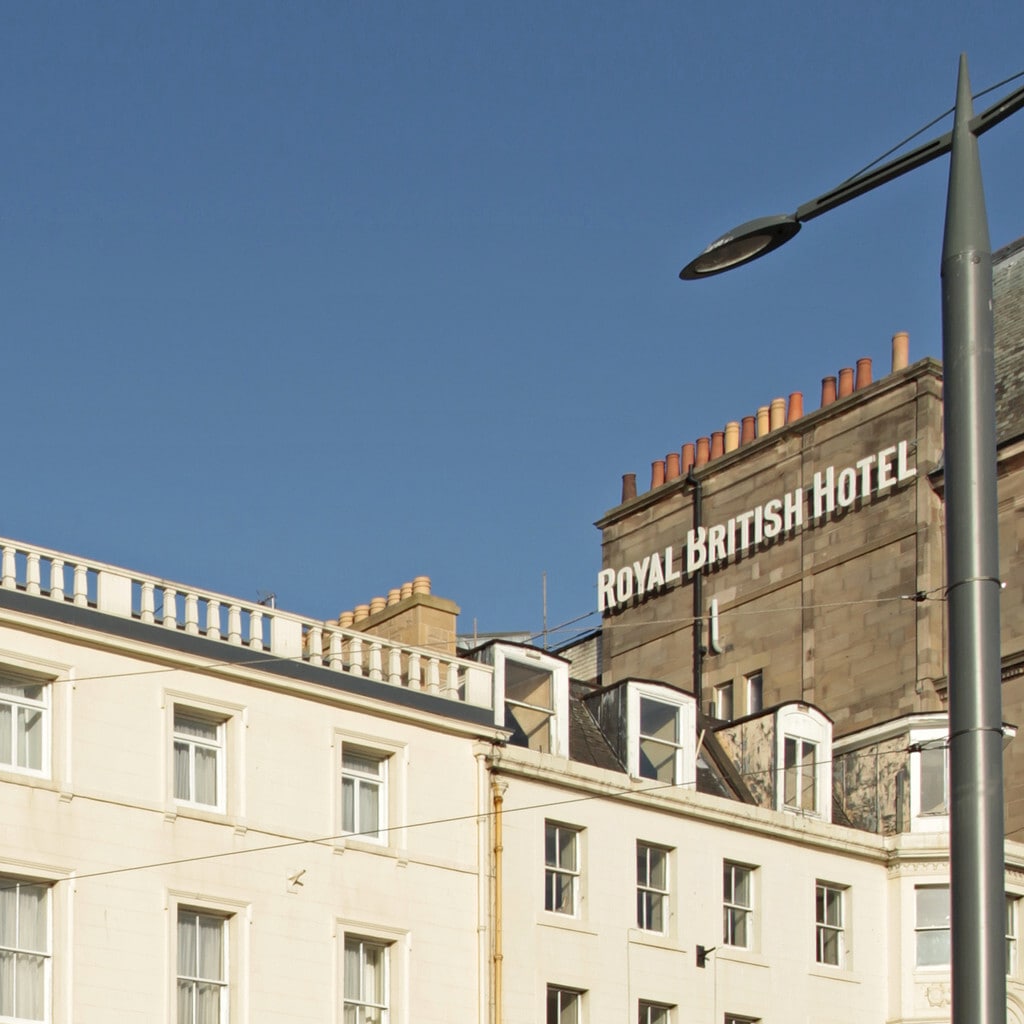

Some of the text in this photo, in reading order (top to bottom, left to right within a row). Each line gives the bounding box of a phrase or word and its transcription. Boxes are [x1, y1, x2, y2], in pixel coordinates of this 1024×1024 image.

[598, 440, 917, 612] ROYAL BRITISH HOTEL
